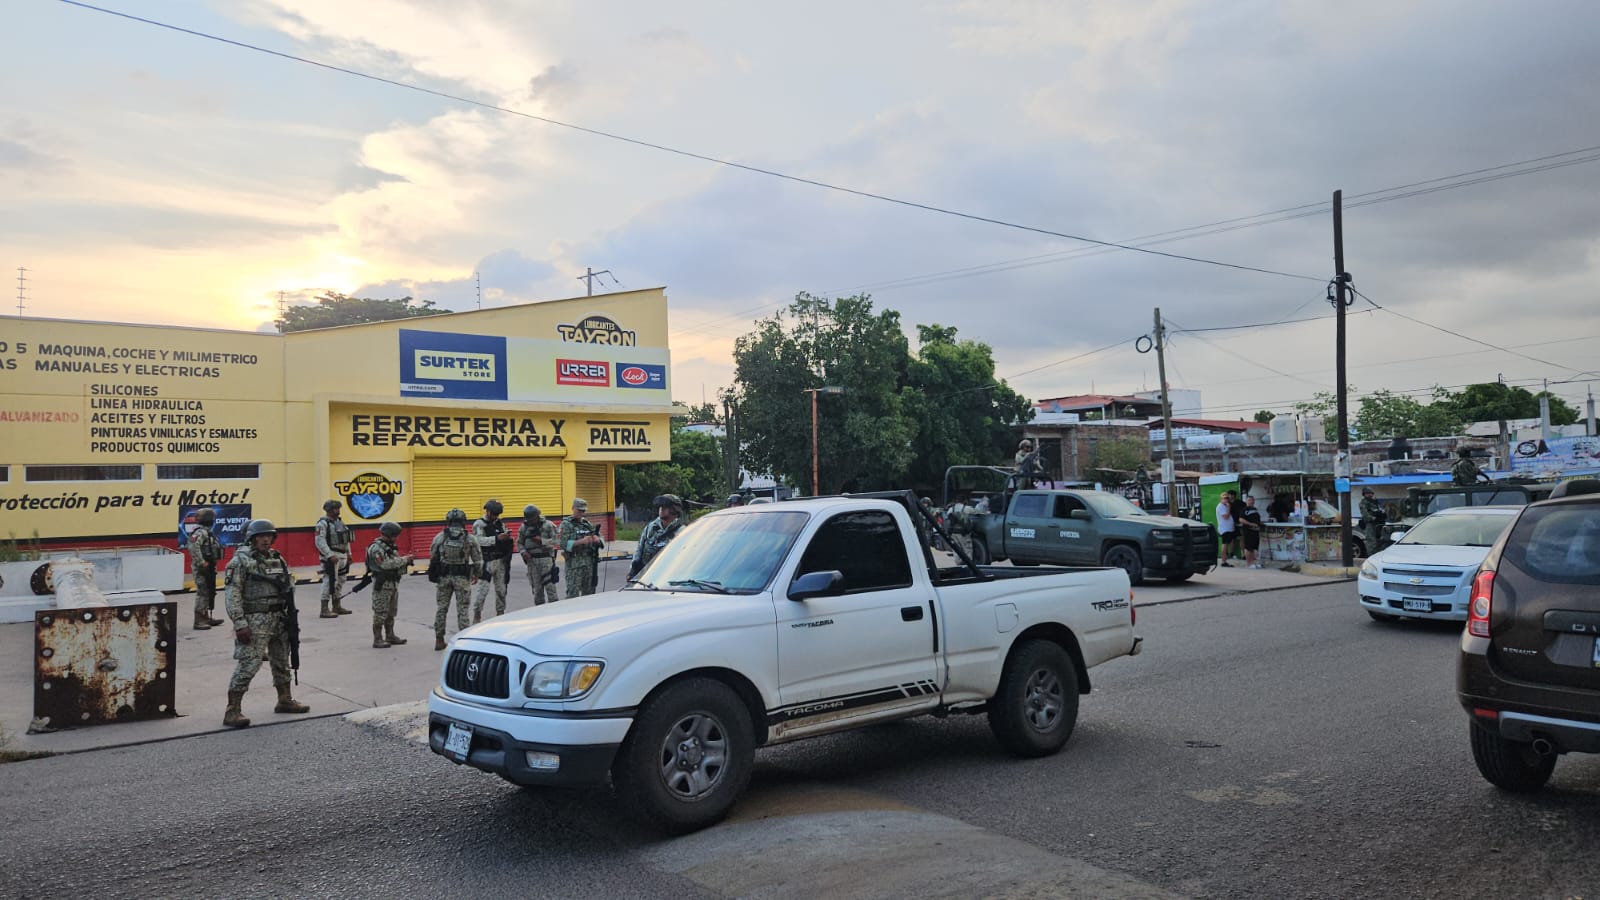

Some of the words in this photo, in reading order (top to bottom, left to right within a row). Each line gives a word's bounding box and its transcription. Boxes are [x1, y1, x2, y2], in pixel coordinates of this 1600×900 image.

[558, 326, 635, 346] TAYRON
[16, 342, 27, 354] 5
[160, 349, 169, 361] Y
[173, 350, 258, 365] MILIMETRICO
[35, 359, 119, 374] MANUALES
[122, 363, 131, 374] Y
[135, 364, 220, 378] ELECTRICAS
[420, 355, 490, 370] SURTEK
[560, 363, 607, 377] URREA
[90, 384, 158, 396] SILICONES
[90, 398, 128, 409] LINEA
[132, 399, 203, 411] HIDRAULICA
[90, 412, 144, 424] ACEITES
[148, 414, 157, 424] Y
[161, 414, 206, 425] FILTROS
[352, 415, 536, 434] FERRETERIA
[550, 419, 565, 434] Y
[91, 427, 147, 438] PINTURAS
[150, 428, 198, 439] VINILICAS
[200, 428, 207, 439] Y
[209, 429, 257, 439] ESMALTES
[352, 432, 566, 447] REFACCIONARIA
[91, 442, 163, 453] PRODUCTOS
[167, 442, 220, 454] QUIMICOS
[336, 482, 401, 495] TAYRON
[94, 494, 145, 513] para
[150, 491, 173, 506] tu
[178, 488, 250, 506] Motor!
[222, 524, 241, 532] AQU
[785, 701, 844, 716] TACOMA
